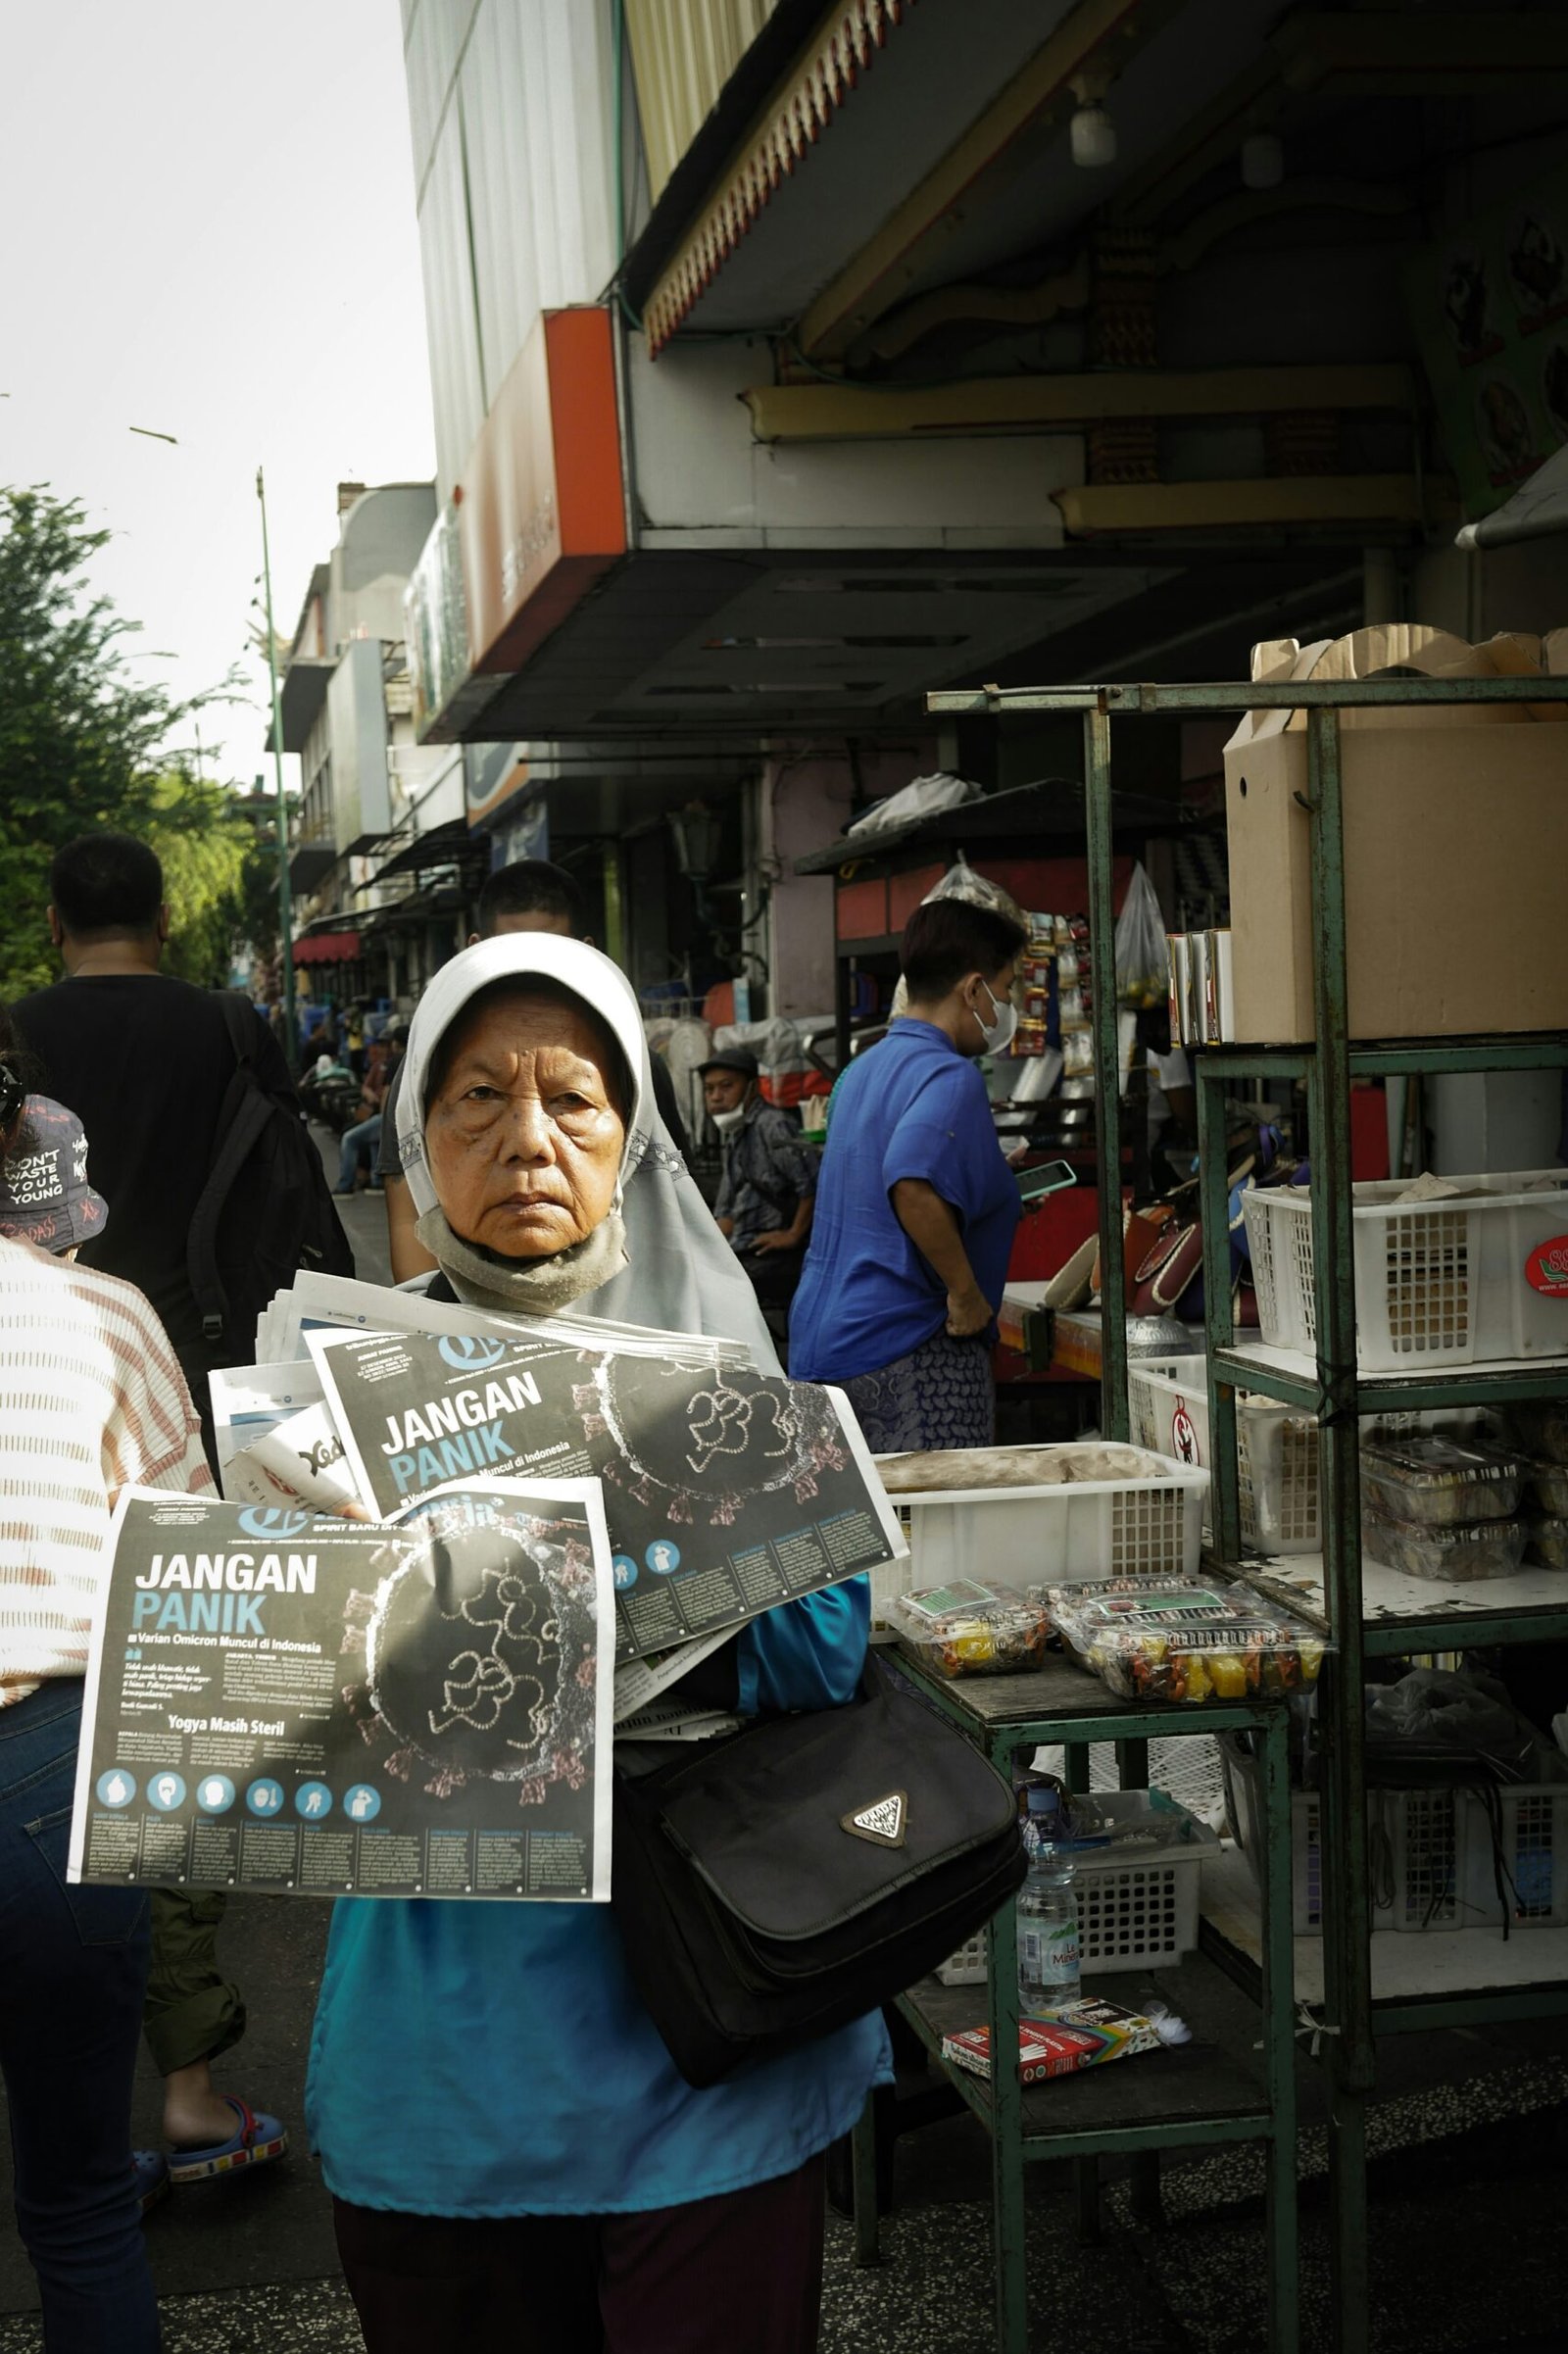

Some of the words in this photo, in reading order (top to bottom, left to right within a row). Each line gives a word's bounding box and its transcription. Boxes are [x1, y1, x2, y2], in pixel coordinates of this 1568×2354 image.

[6, 1163, 57, 1181] WASTE
[8, 1174, 60, 1193] YOUR
[11, 1184, 63, 1204] YOUNG
[381, 1371, 542, 1455] JANGAN
[388, 1420, 515, 1494] PANIK
[514, 1455, 525, 1467] di
[525, 1441, 570, 1464] Indonesia
[313, 1523, 347, 1532] SPIRIT
[349, 1523, 380, 1532] BARU
[135, 1553, 318, 1594] JANGAN
[132, 1591, 267, 1635] PANIK
[137, 1633, 171, 1643] Varian
[173, 1635, 218, 1646] Omicron
[220, 1637, 257, 1649] Muncul
[260, 1639, 270, 1649] di
[271, 1641, 321, 1653] Indonesia
[169, 1715, 207, 1733] Yogya
[210, 1717, 246, 1732] Masih
[251, 1720, 285, 1736] Steril
